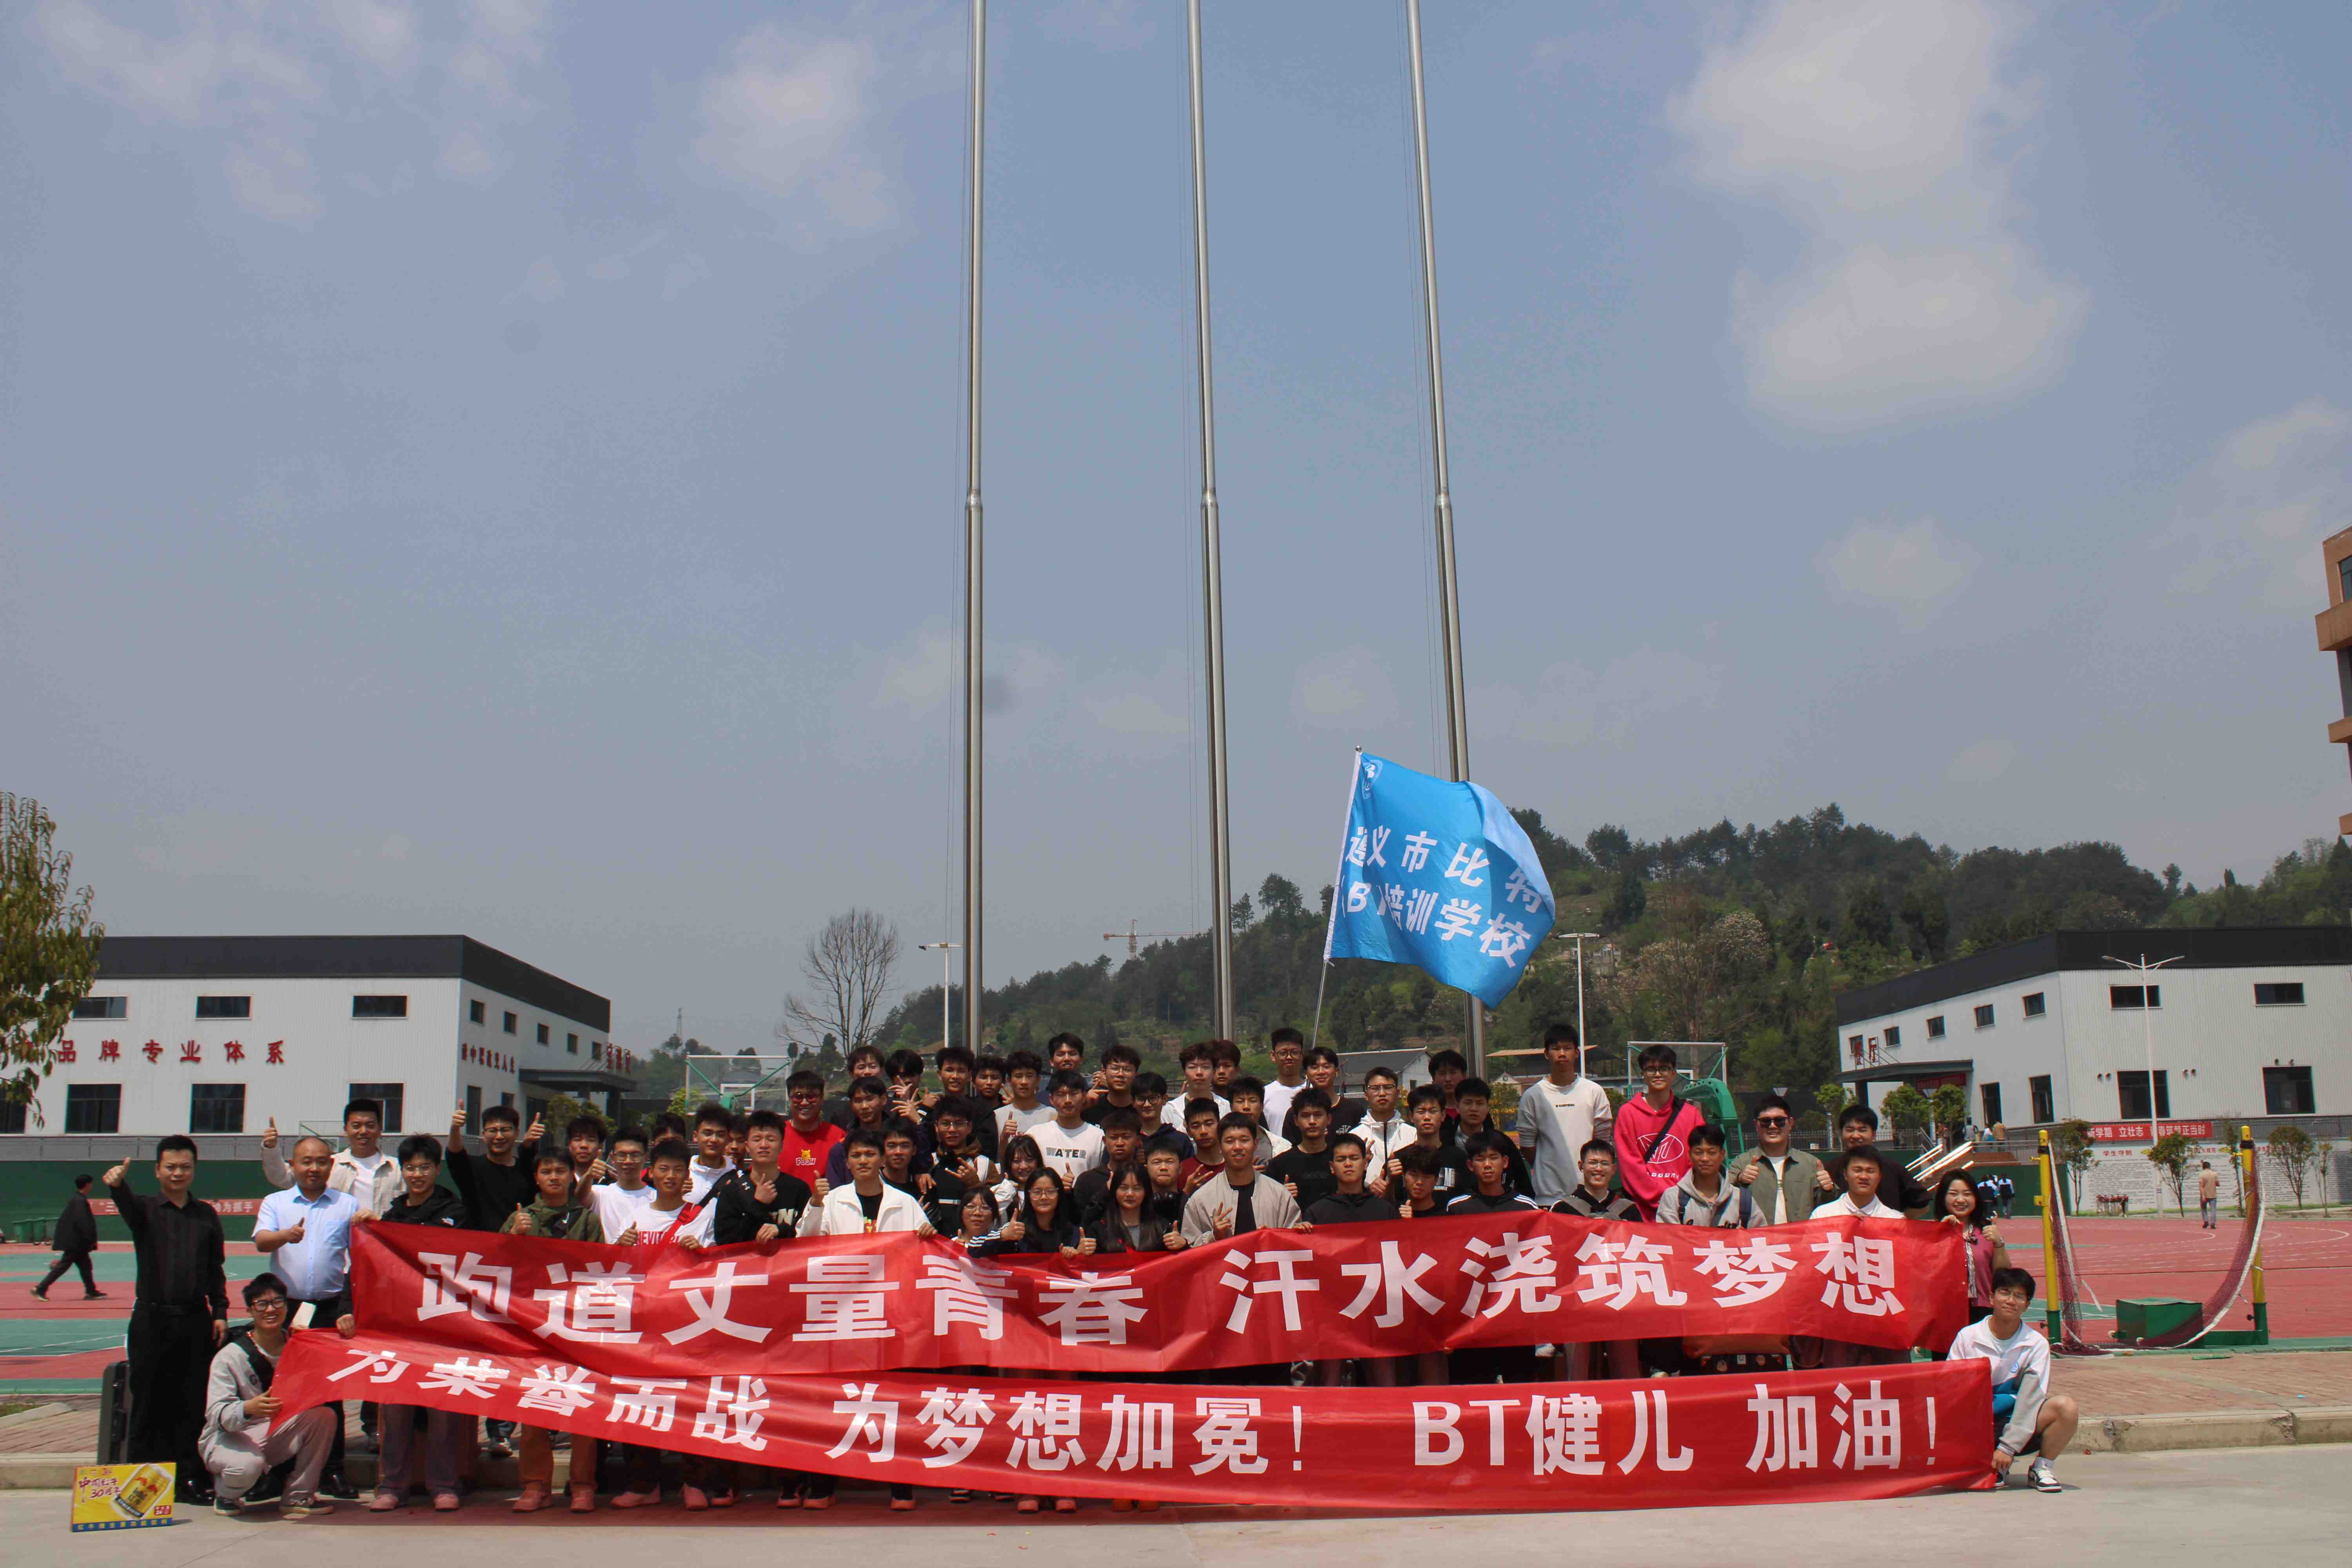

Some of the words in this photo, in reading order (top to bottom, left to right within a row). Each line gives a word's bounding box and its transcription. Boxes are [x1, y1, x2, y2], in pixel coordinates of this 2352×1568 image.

[795, 1157, 816, 1166] POOH
[417, 1251, 1147, 1345] 跑道丈量青春
[1220, 1232, 1905, 1334] 汗水浇筑梦想
[327, 1349, 769, 1452] 为荣誉而战
[1413, 1390, 1693, 1475] BT健儿
[1745, 1380, 1936, 1472] 加油！
